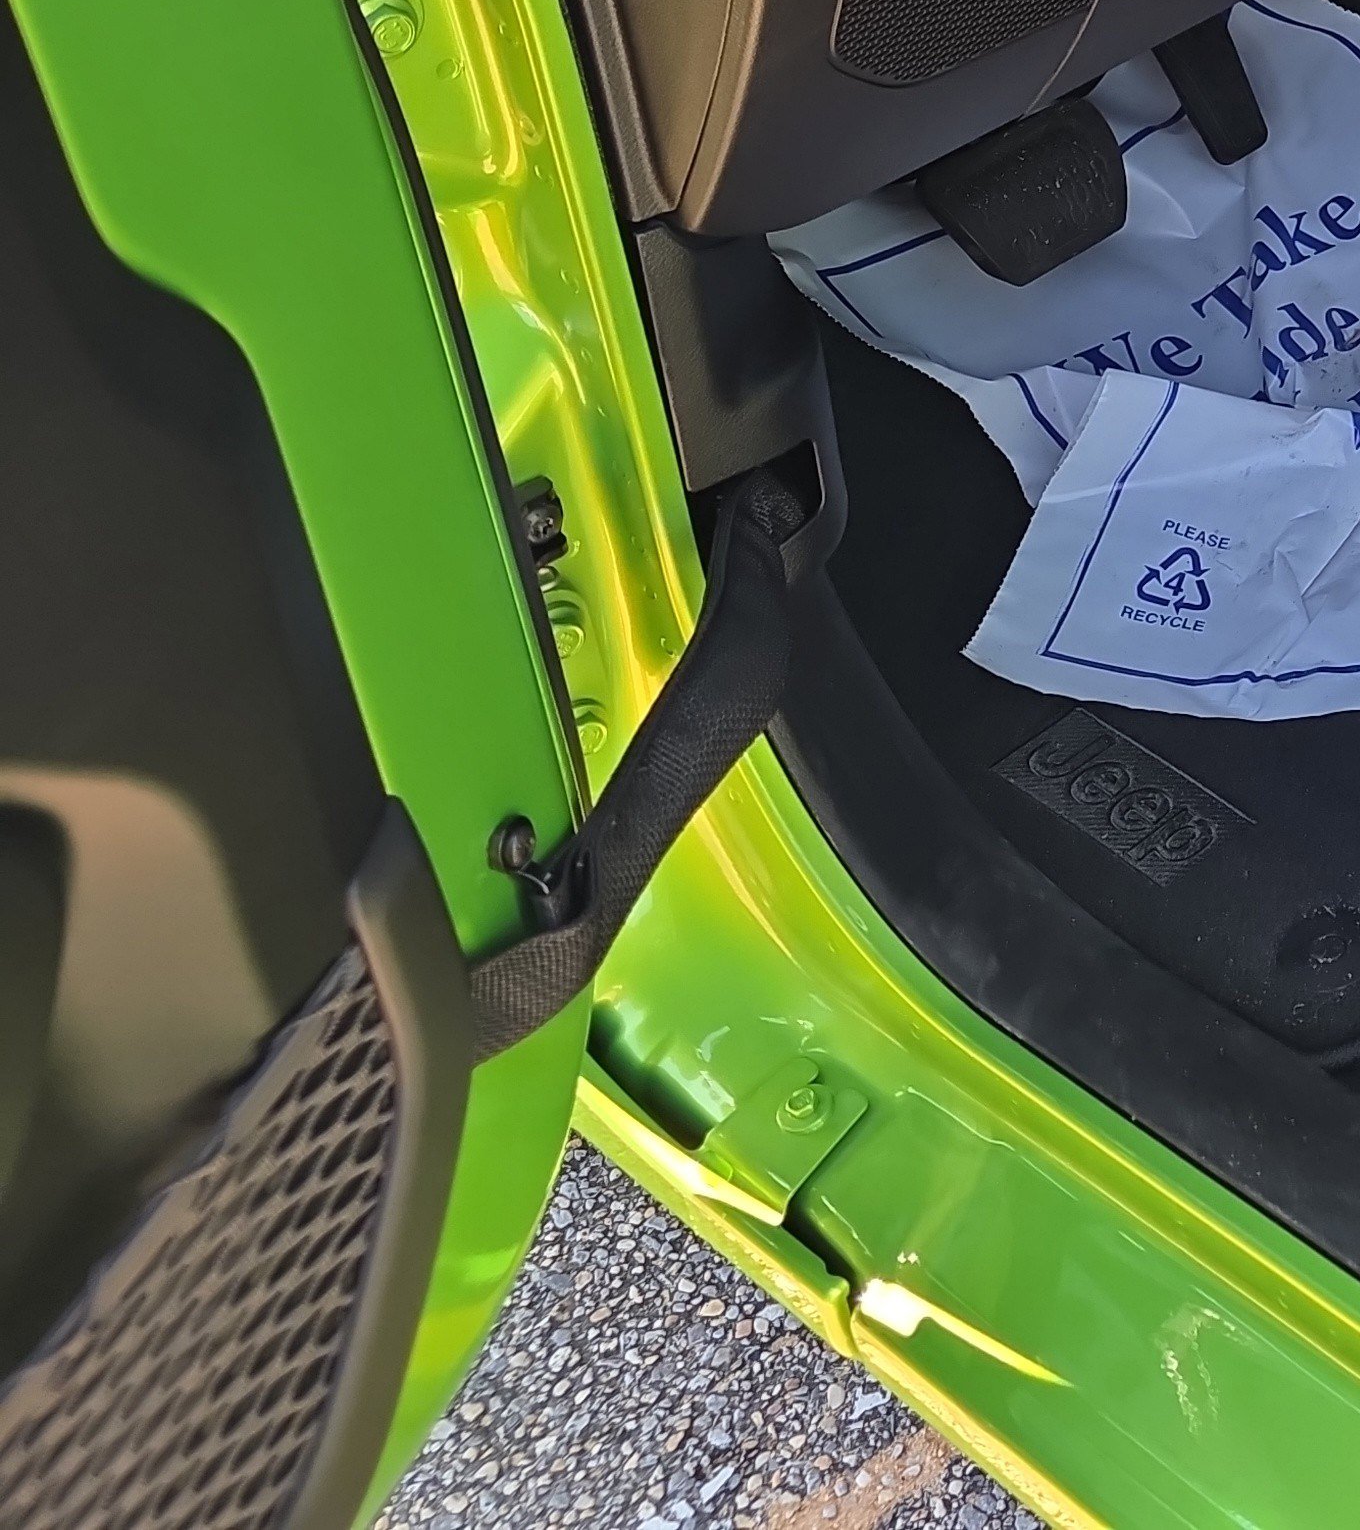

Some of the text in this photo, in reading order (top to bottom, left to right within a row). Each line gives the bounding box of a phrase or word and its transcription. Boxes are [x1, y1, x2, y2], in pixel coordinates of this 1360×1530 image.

[1162, 519, 1231, 550] PLEASE
[1163, 571, 1186, 597] 4
[1120, 605, 1206, 632] RECYCLE
[1028, 734, 1217, 862] Jeep
